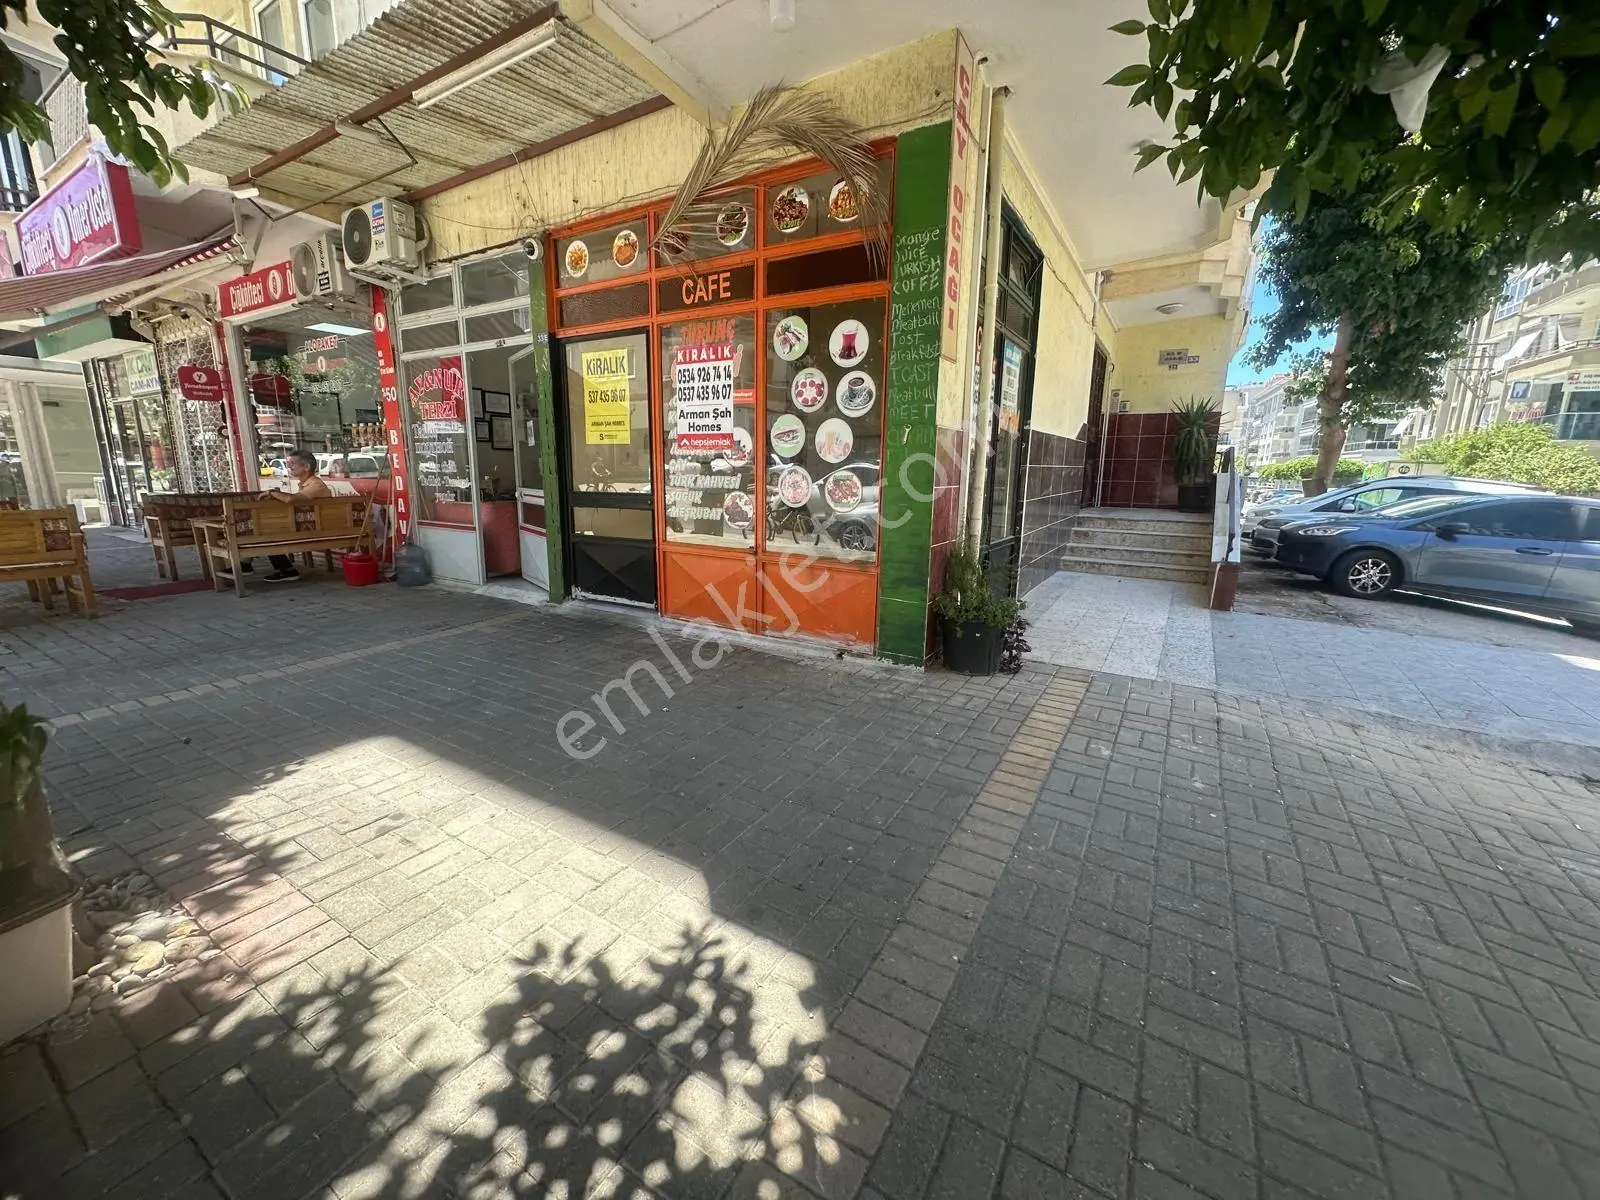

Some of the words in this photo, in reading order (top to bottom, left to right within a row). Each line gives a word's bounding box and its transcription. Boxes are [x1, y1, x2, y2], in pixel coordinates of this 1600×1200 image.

[947, 184, 964, 331] OCAĞI
[682, 271, 731, 304] CAFE
[677, 367, 696, 385] 0534
[697, 366, 711, 384] 926
[712, 365, 722, 382] 74
[723, 364, 732, 382] 14
[588, 390, 599, 404] 537
[600, 389, 610, 403] 435
[677, 386, 696, 403] 0537
[696, 385, 711, 402] 435
[711, 384, 721, 401] 96
[721, 383, 732, 400] 07
[679, 409, 710, 420] Arman
[712, 407, 732, 421] Şah
[687, 422, 722, 433] Homes
[690, 437, 731, 447] hepsiemlak
